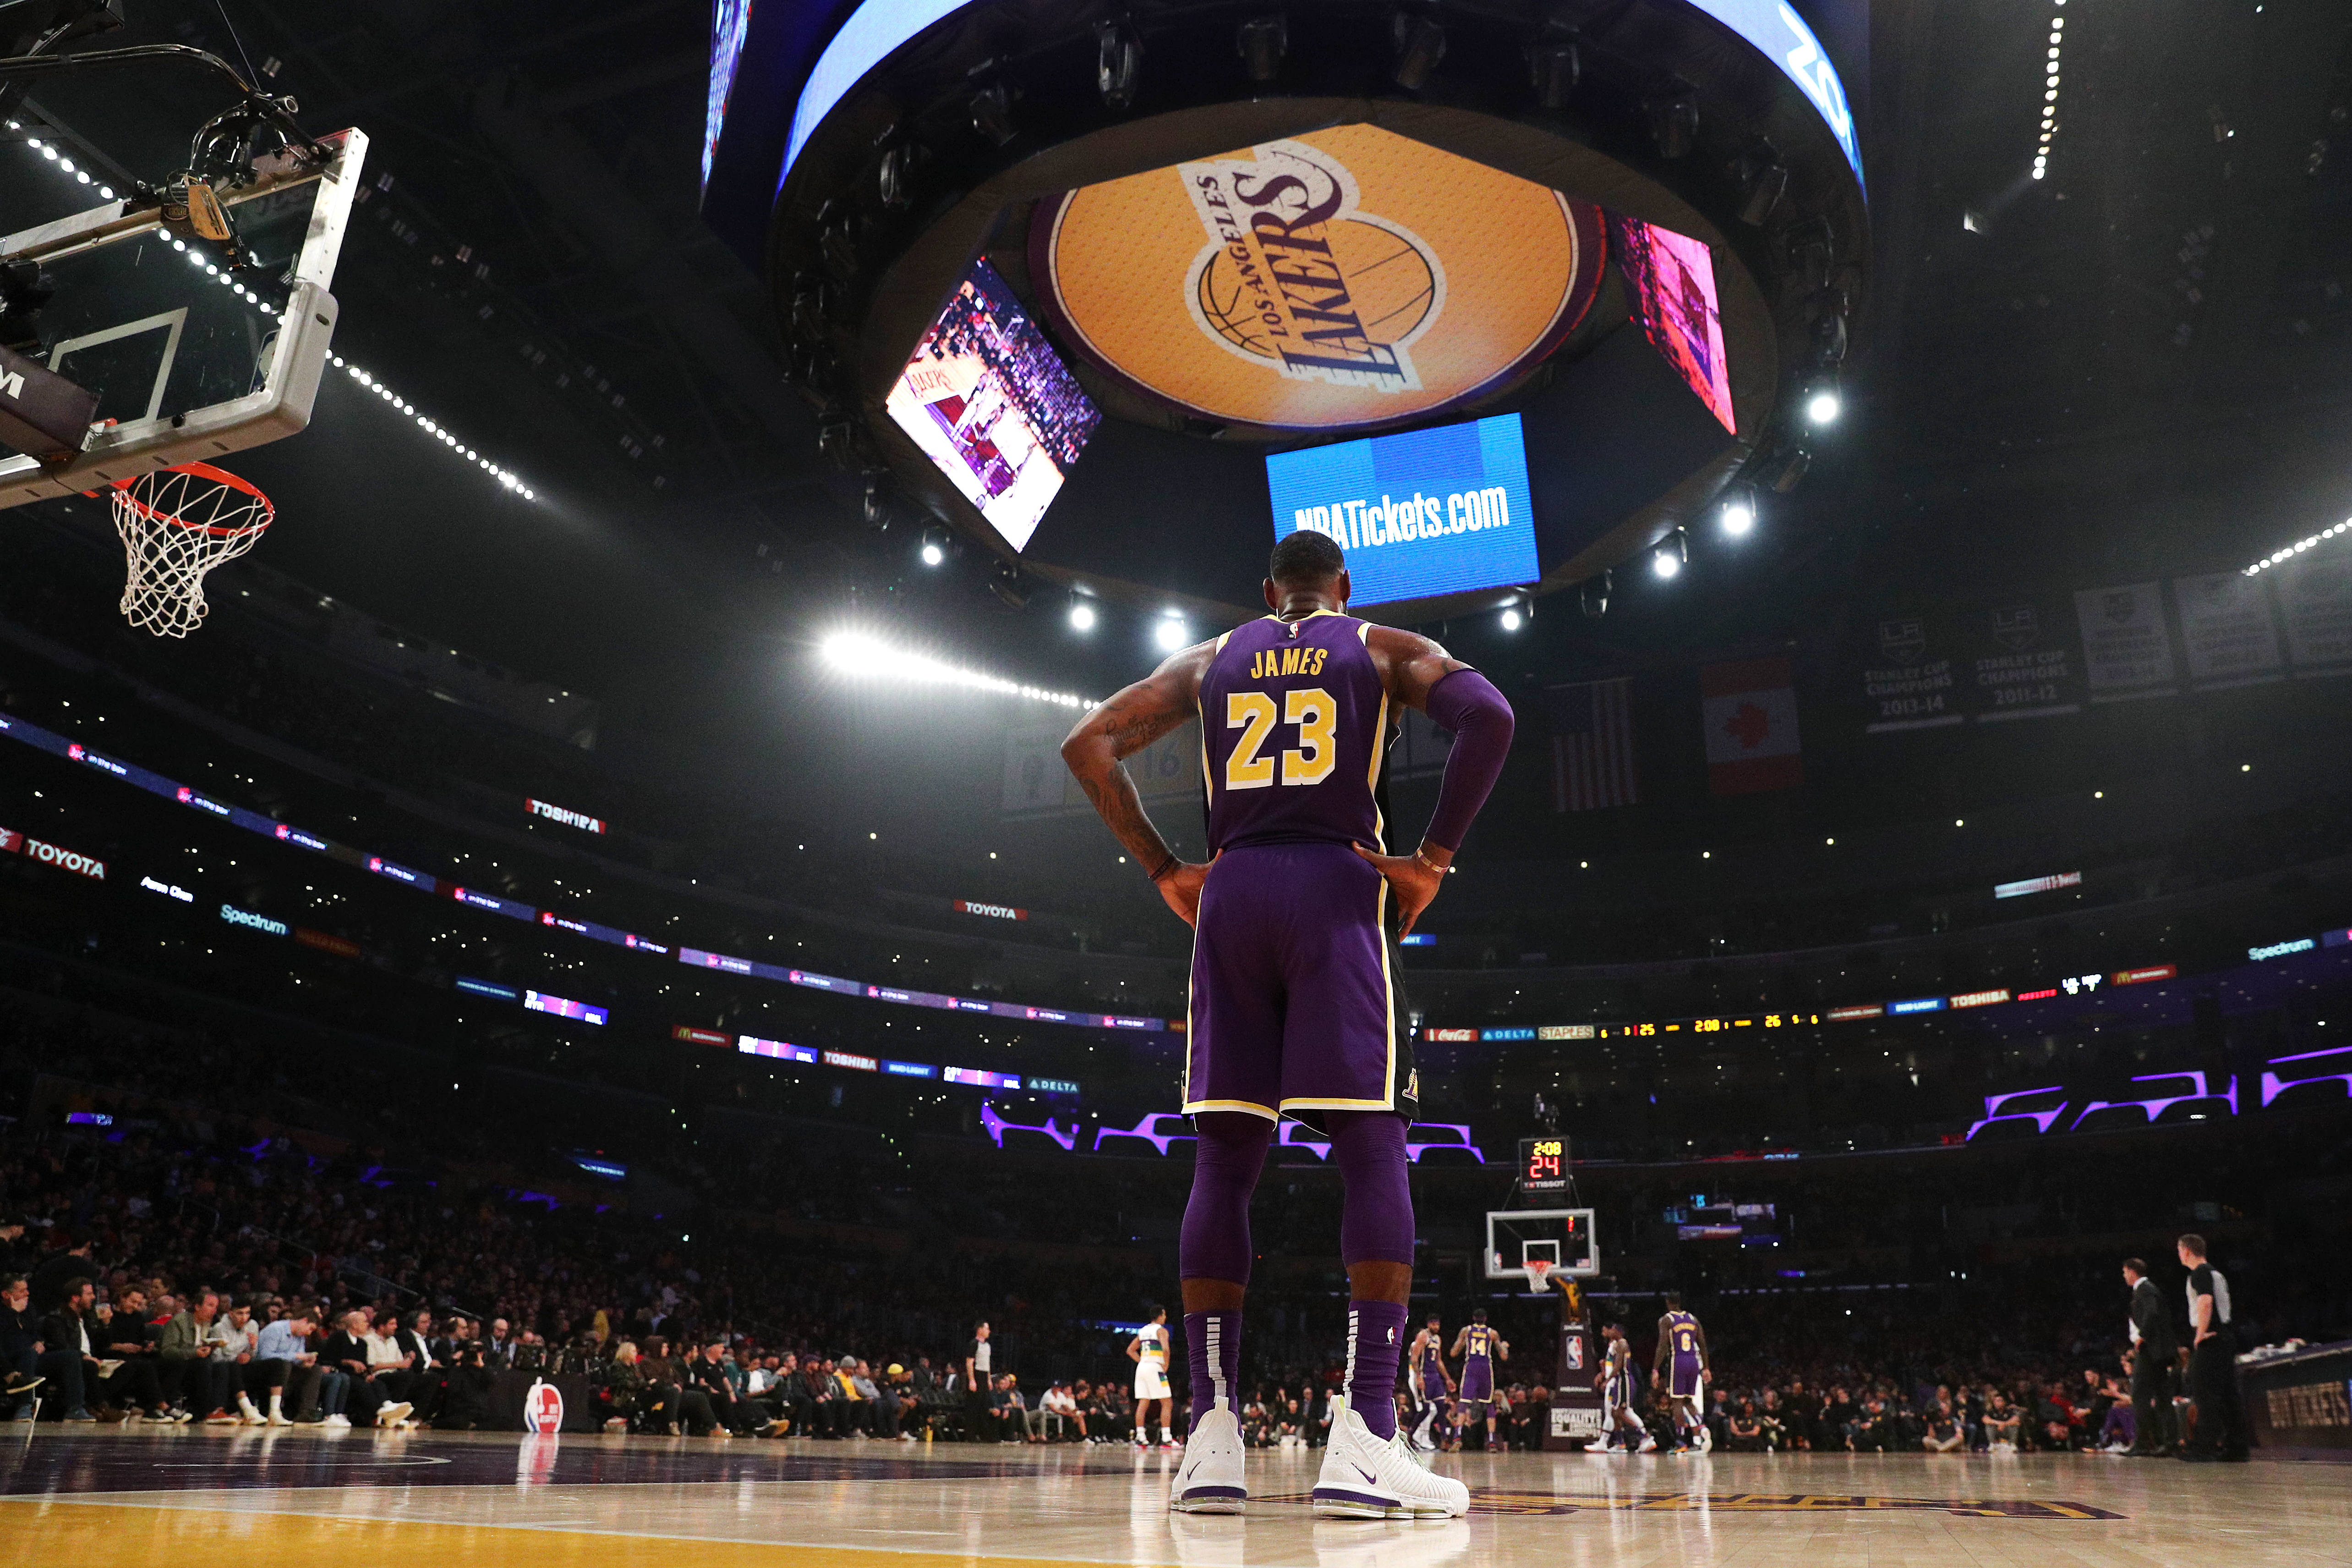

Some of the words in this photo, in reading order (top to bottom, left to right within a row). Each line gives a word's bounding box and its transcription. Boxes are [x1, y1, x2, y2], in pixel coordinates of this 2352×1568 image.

[1196, 175, 1270, 296] ANGELES
[1232, 150, 1406, 383] LAKERS
[1254, 299, 1289, 338] LOS
[1250, 647, 1328, 679] JAMES
[1226, 688, 1337, 791] 23
[27, 838, 105, 880] TOYOTA
[220, 904, 287, 935] Spectrum
[965, 901, 1017, 920] TOYOTA
[2248, 939, 2314, 962] Spectrum
[1950, 990, 2010, 1008] TOSHIBA
[1495, 1028, 1536, 1039] DELTA
[1539, 1025, 1593, 1040] STAPLES
[1601, 1029, 1608, 1039] 6
[1640, 1023, 1655, 1036] 25
[1695, 1019, 1720, 1032] 2:08
[1765, 1015, 1781, 1027] 26
[824, 1051, 877, 1071] TOSHIBA
[1040, 1080, 1078, 1092] DELTA
[1533, 1142, 1562, 1156] 2:08
[1529, 1156, 1560, 1179] 24
[1536, 1180, 1566, 1188] TISSOT
[1470, 1338, 1486, 1356] 14
[1681, 1333, 1691, 1352] 6
